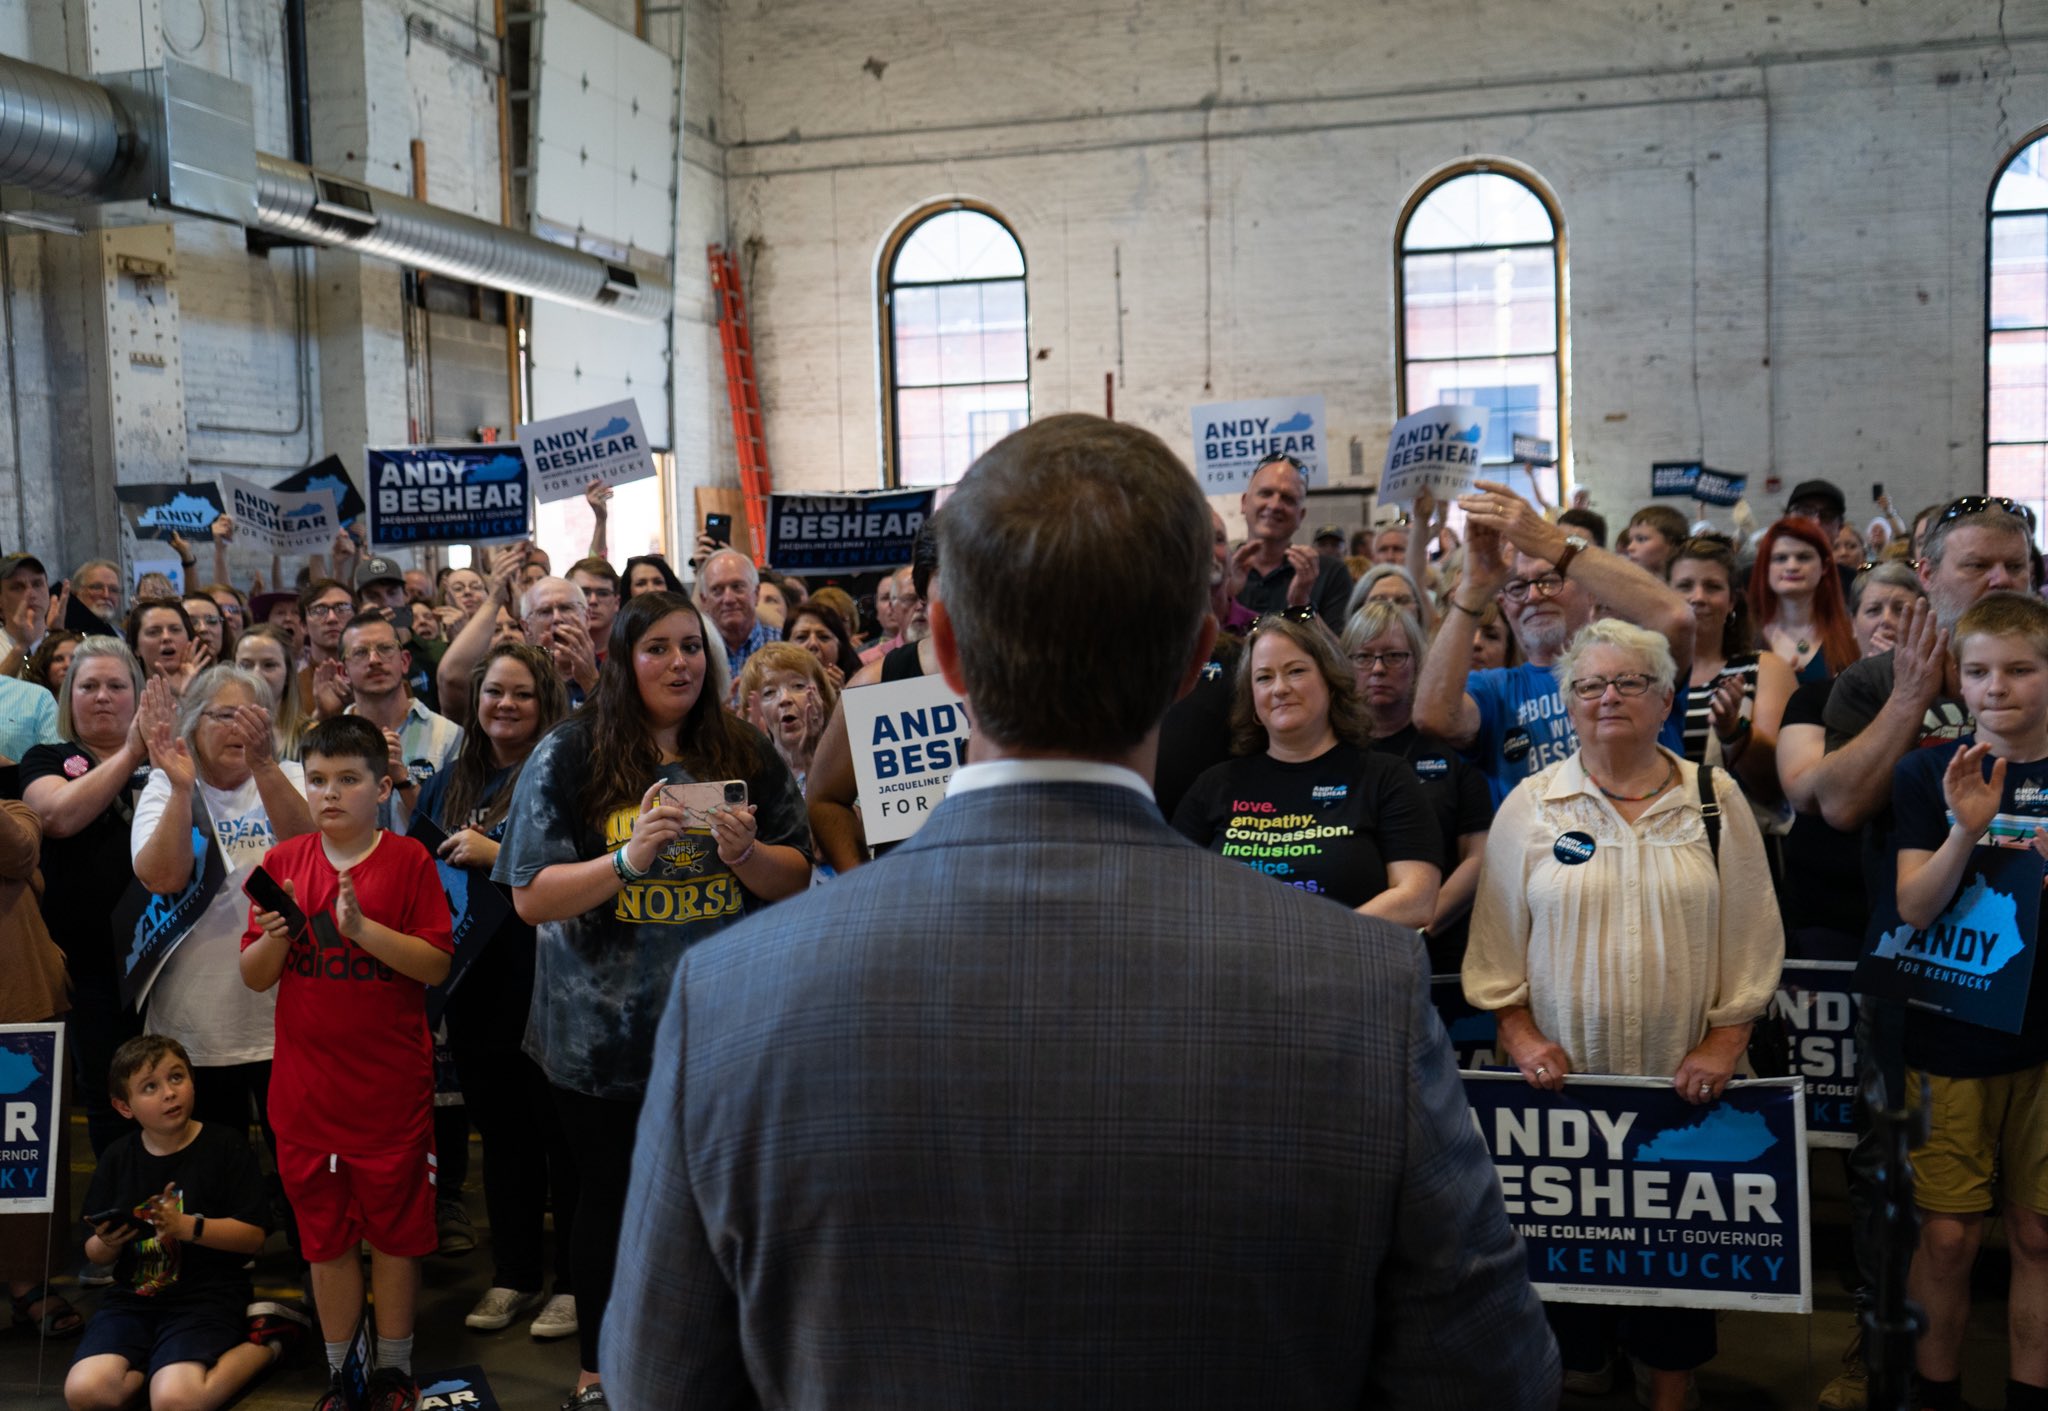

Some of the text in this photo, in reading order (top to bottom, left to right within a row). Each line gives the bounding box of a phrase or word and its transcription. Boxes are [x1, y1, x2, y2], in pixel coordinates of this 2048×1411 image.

[533, 426, 588, 455] ANDY
[1205, 417, 1270, 440] ANDY
[1396, 423, 1451, 450] ANDY
[535, 434, 638, 473] BESHEAR
[1205, 434, 1315, 460] BESHEAR
[1390, 443, 1479, 471] BESHEAR
[379, 460, 466, 487] ANDY
[544, 460, 645, 491] FOR KENTUCKY
[1208, 471, 1234, 482] FOR
[234, 488, 282, 516] ANDY
[378, 482, 523, 514] BESHEAR
[155, 509, 204, 524] ANDY
[235, 502, 328, 533] BESHEAR
[379, 519, 523, 540] FOR KENTUCKY
[779, 512, 925, 540] BESHEAR
[878, 777, 941, 794] JACQUELINE
[881, 796, 929, 817] FOR
[1232, 800, 1277, 813] love.
[1225, 825, 1354, 845] compassion.
[1230, 814, 1317, 831] empathy.
[1222, 842, 1323, 857] inclusion.
[1556, 841, 1592, 857] BESHEAR
[1559, 835, 1582, 846] ANDY
[1906, 923, 2000, 968] ANDY
[1897, 960, 1993, 992] FOR KENTUCKY
[1469, 1107, 1639, 1161] NDY
[1552, 1225, 1636, 1241] COLEMAN
[1657, 1228, 1680, 1243] LT
[1683, 1230, 1784, 1248] GOVERNOR
[1547, 1247, 1785, 1282] KENTUCKY
